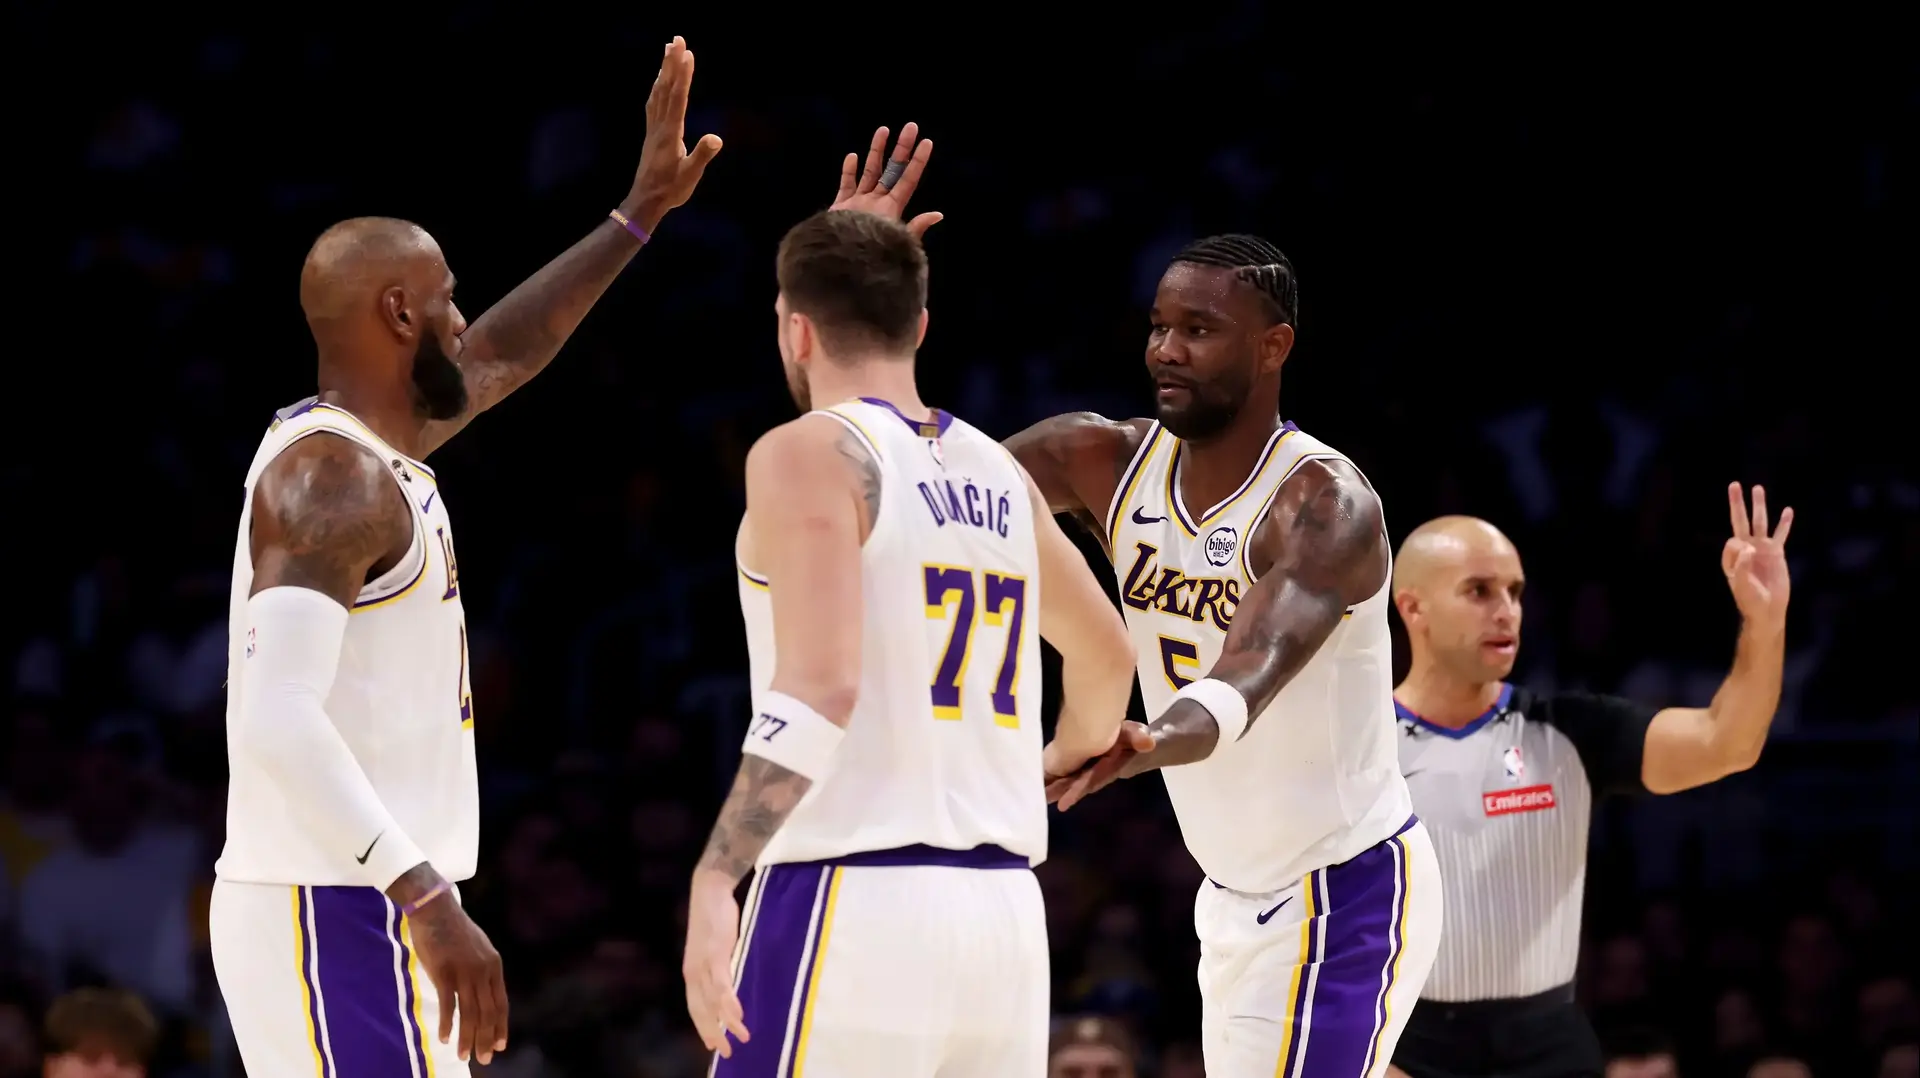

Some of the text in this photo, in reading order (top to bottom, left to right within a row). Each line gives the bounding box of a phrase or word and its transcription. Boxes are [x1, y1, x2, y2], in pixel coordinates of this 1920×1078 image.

[1208, 537, 1236, 555] bibigo
[1122, 540, 1240, 634] LAKERS
[921, 562, 1028, 729] 77
[751, 712, 789, 743] 77
[1485, 791, 1553, 812] Emirates
